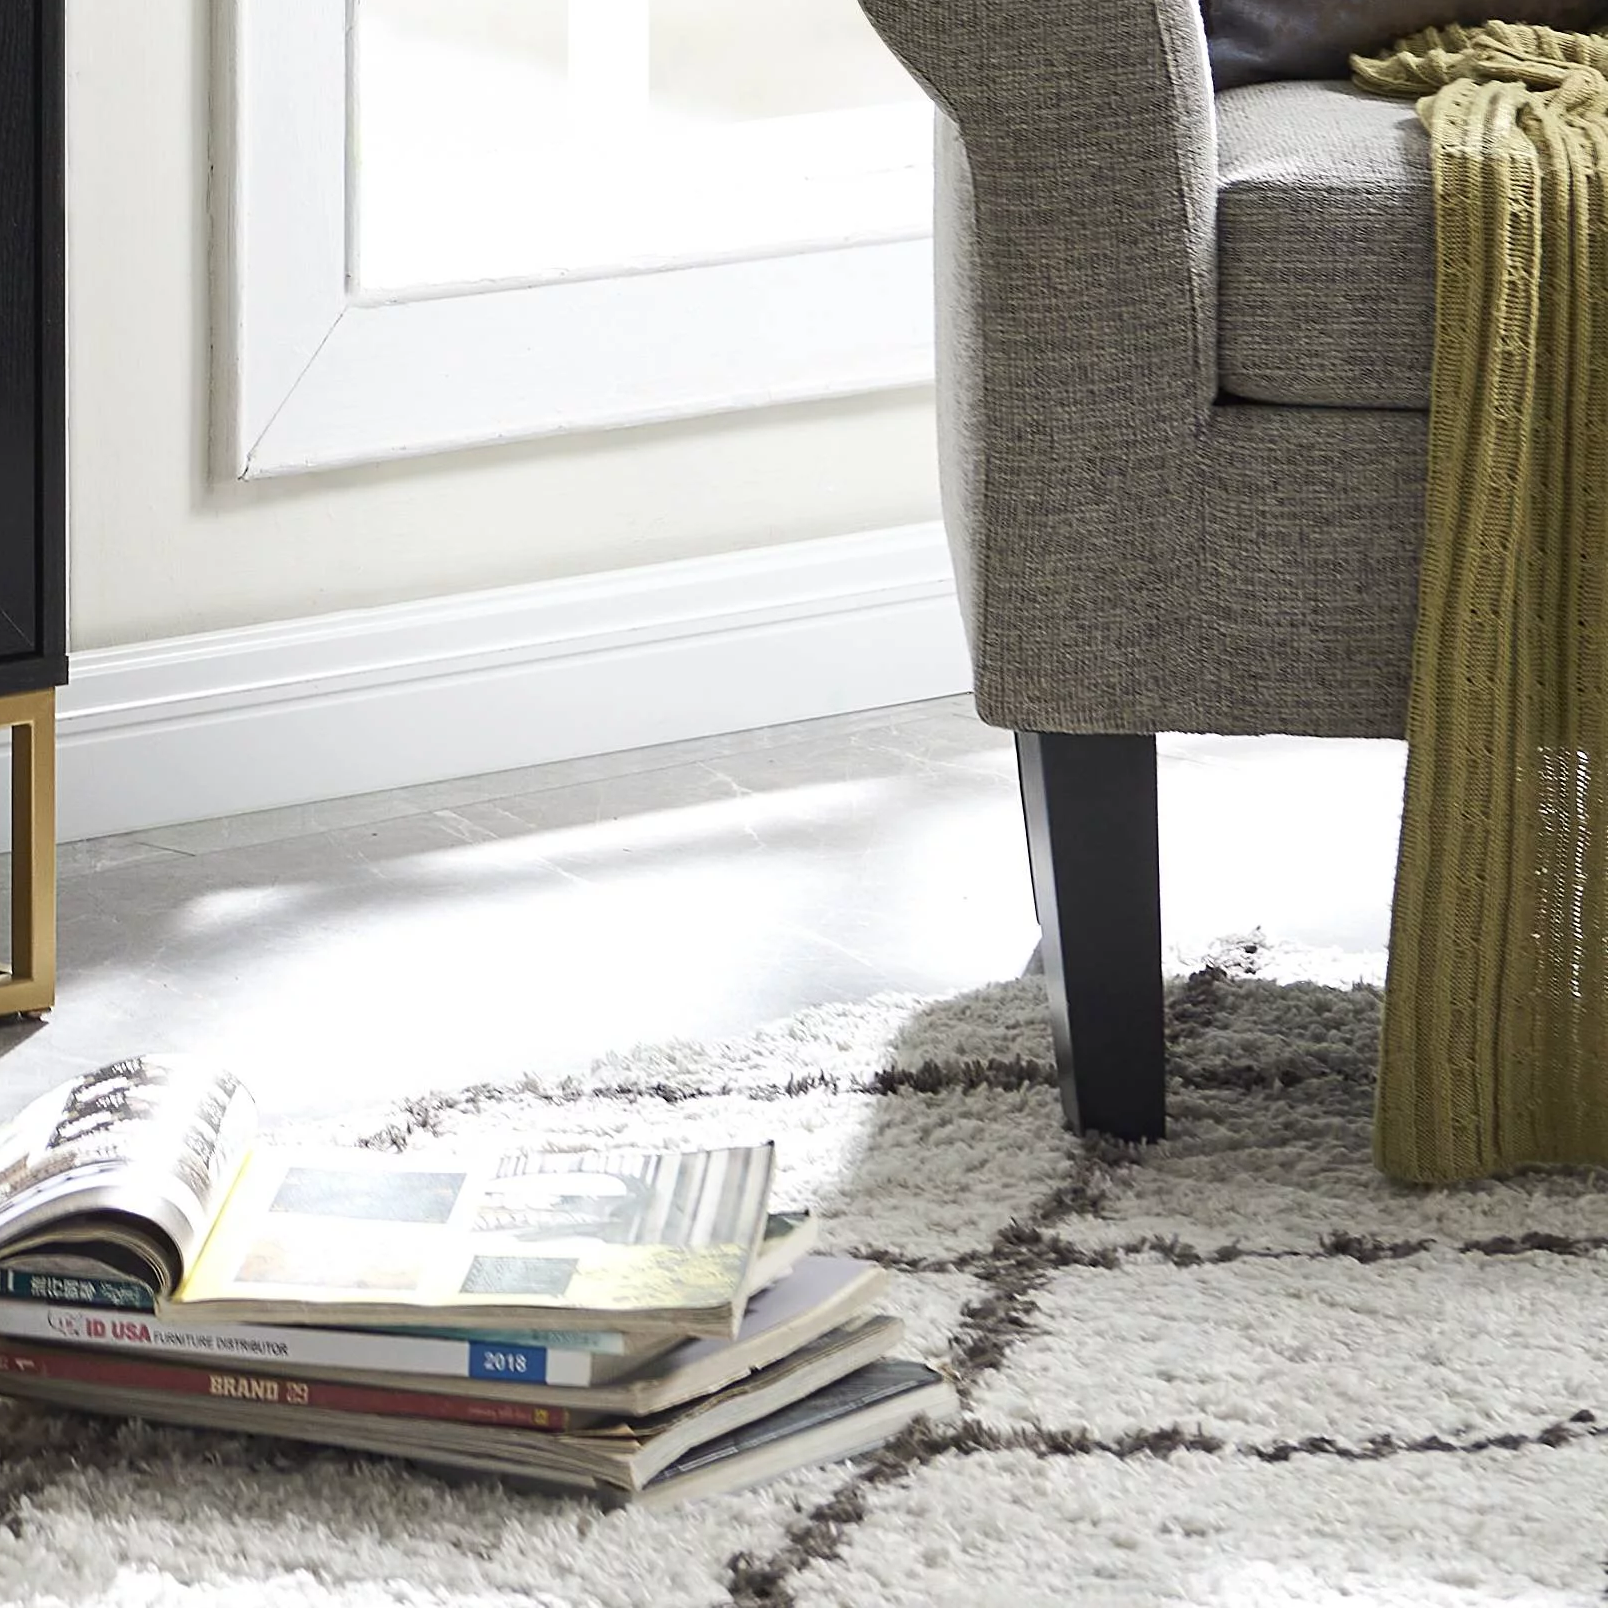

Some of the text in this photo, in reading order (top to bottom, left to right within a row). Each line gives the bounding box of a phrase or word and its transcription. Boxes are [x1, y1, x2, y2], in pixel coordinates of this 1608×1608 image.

[85, 1318, 106, 1339] ID
[111, 1321, 152, 1343] USA
[217, 1334, 289, 1357] DISTRIBUTOR
[484, 1351, 527, 1373] 2018
[209, 1374, 279, 1401] BRAND
